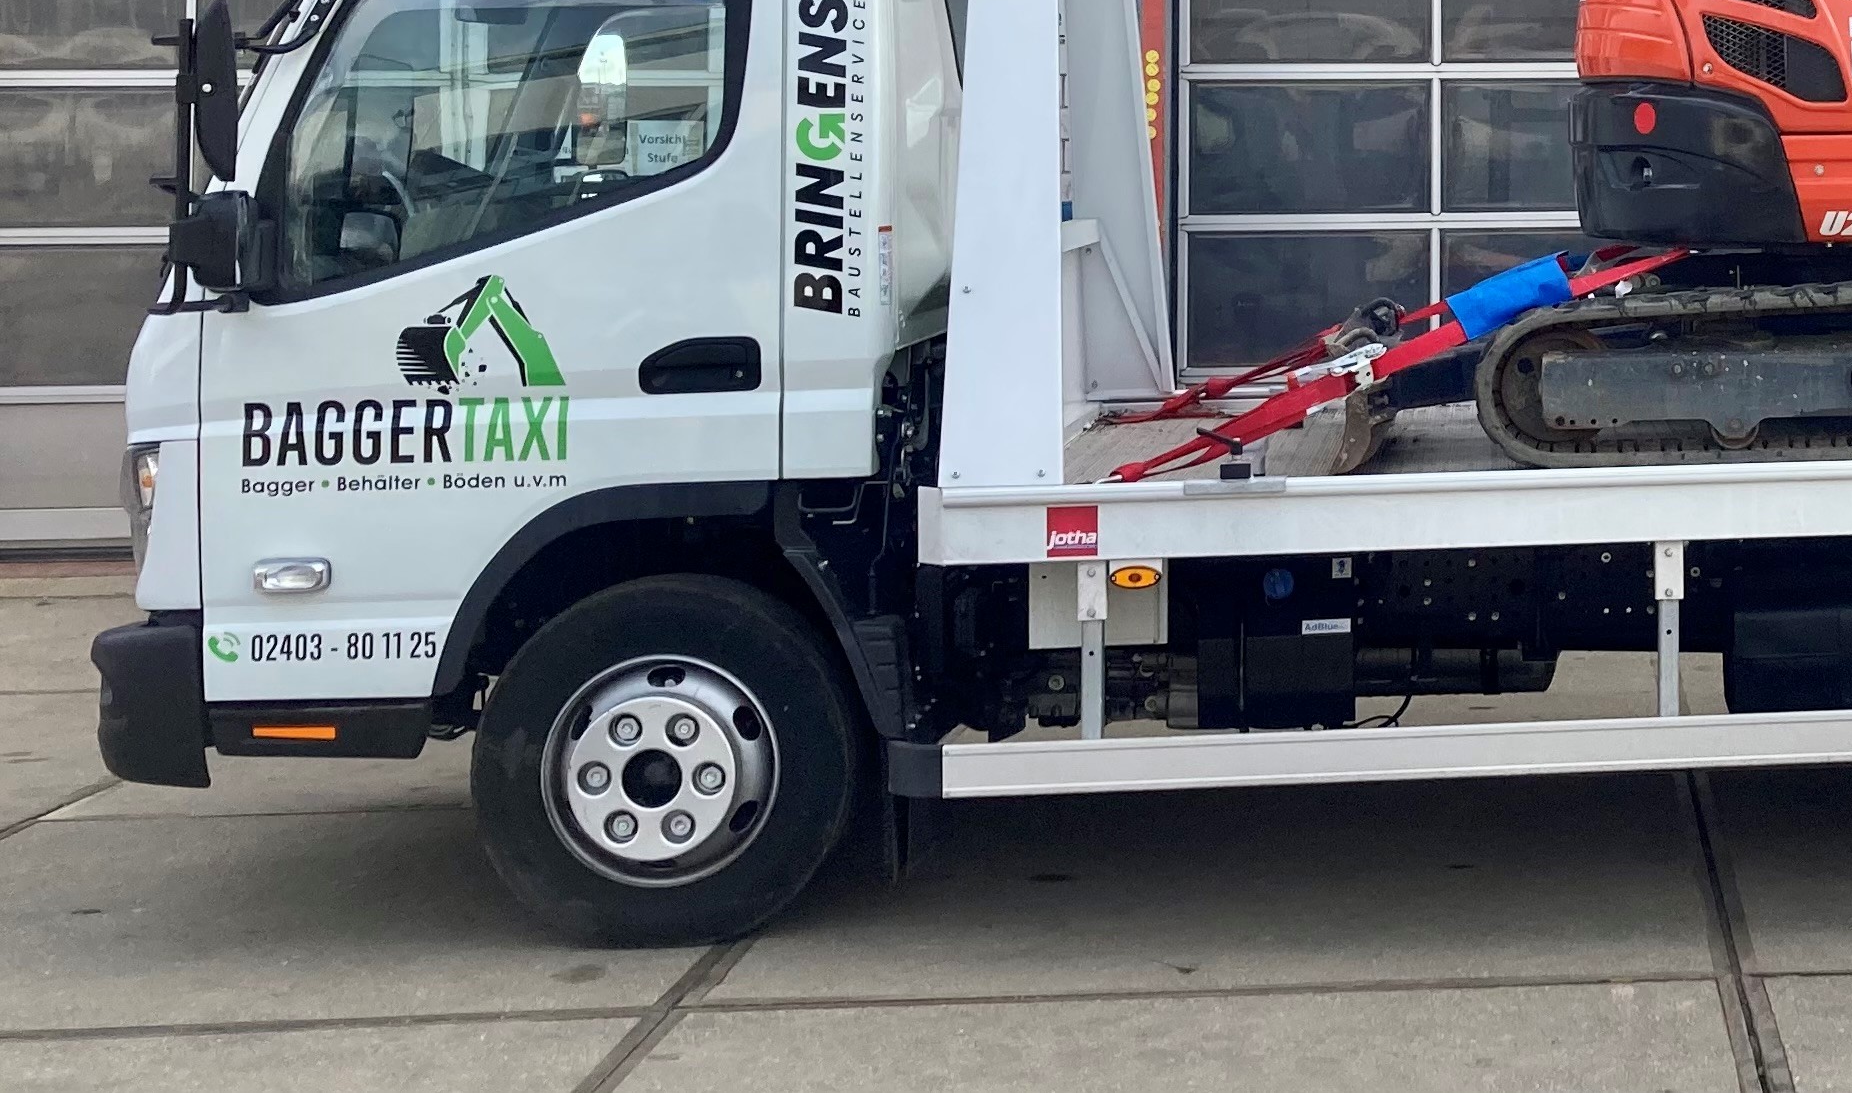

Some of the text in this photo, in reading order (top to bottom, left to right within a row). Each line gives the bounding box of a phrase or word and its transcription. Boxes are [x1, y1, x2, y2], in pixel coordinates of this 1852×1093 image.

[241, 472, 568, 497] Bagger Behälter Böden u.v.m
[1046, 529, 1098, 551] jotha
[251, 633, 322, 662] 02403
[347, 632, 374, 660] 80
[381, 631, 402, 660] 11
[410, 631, 437, 659] 25
